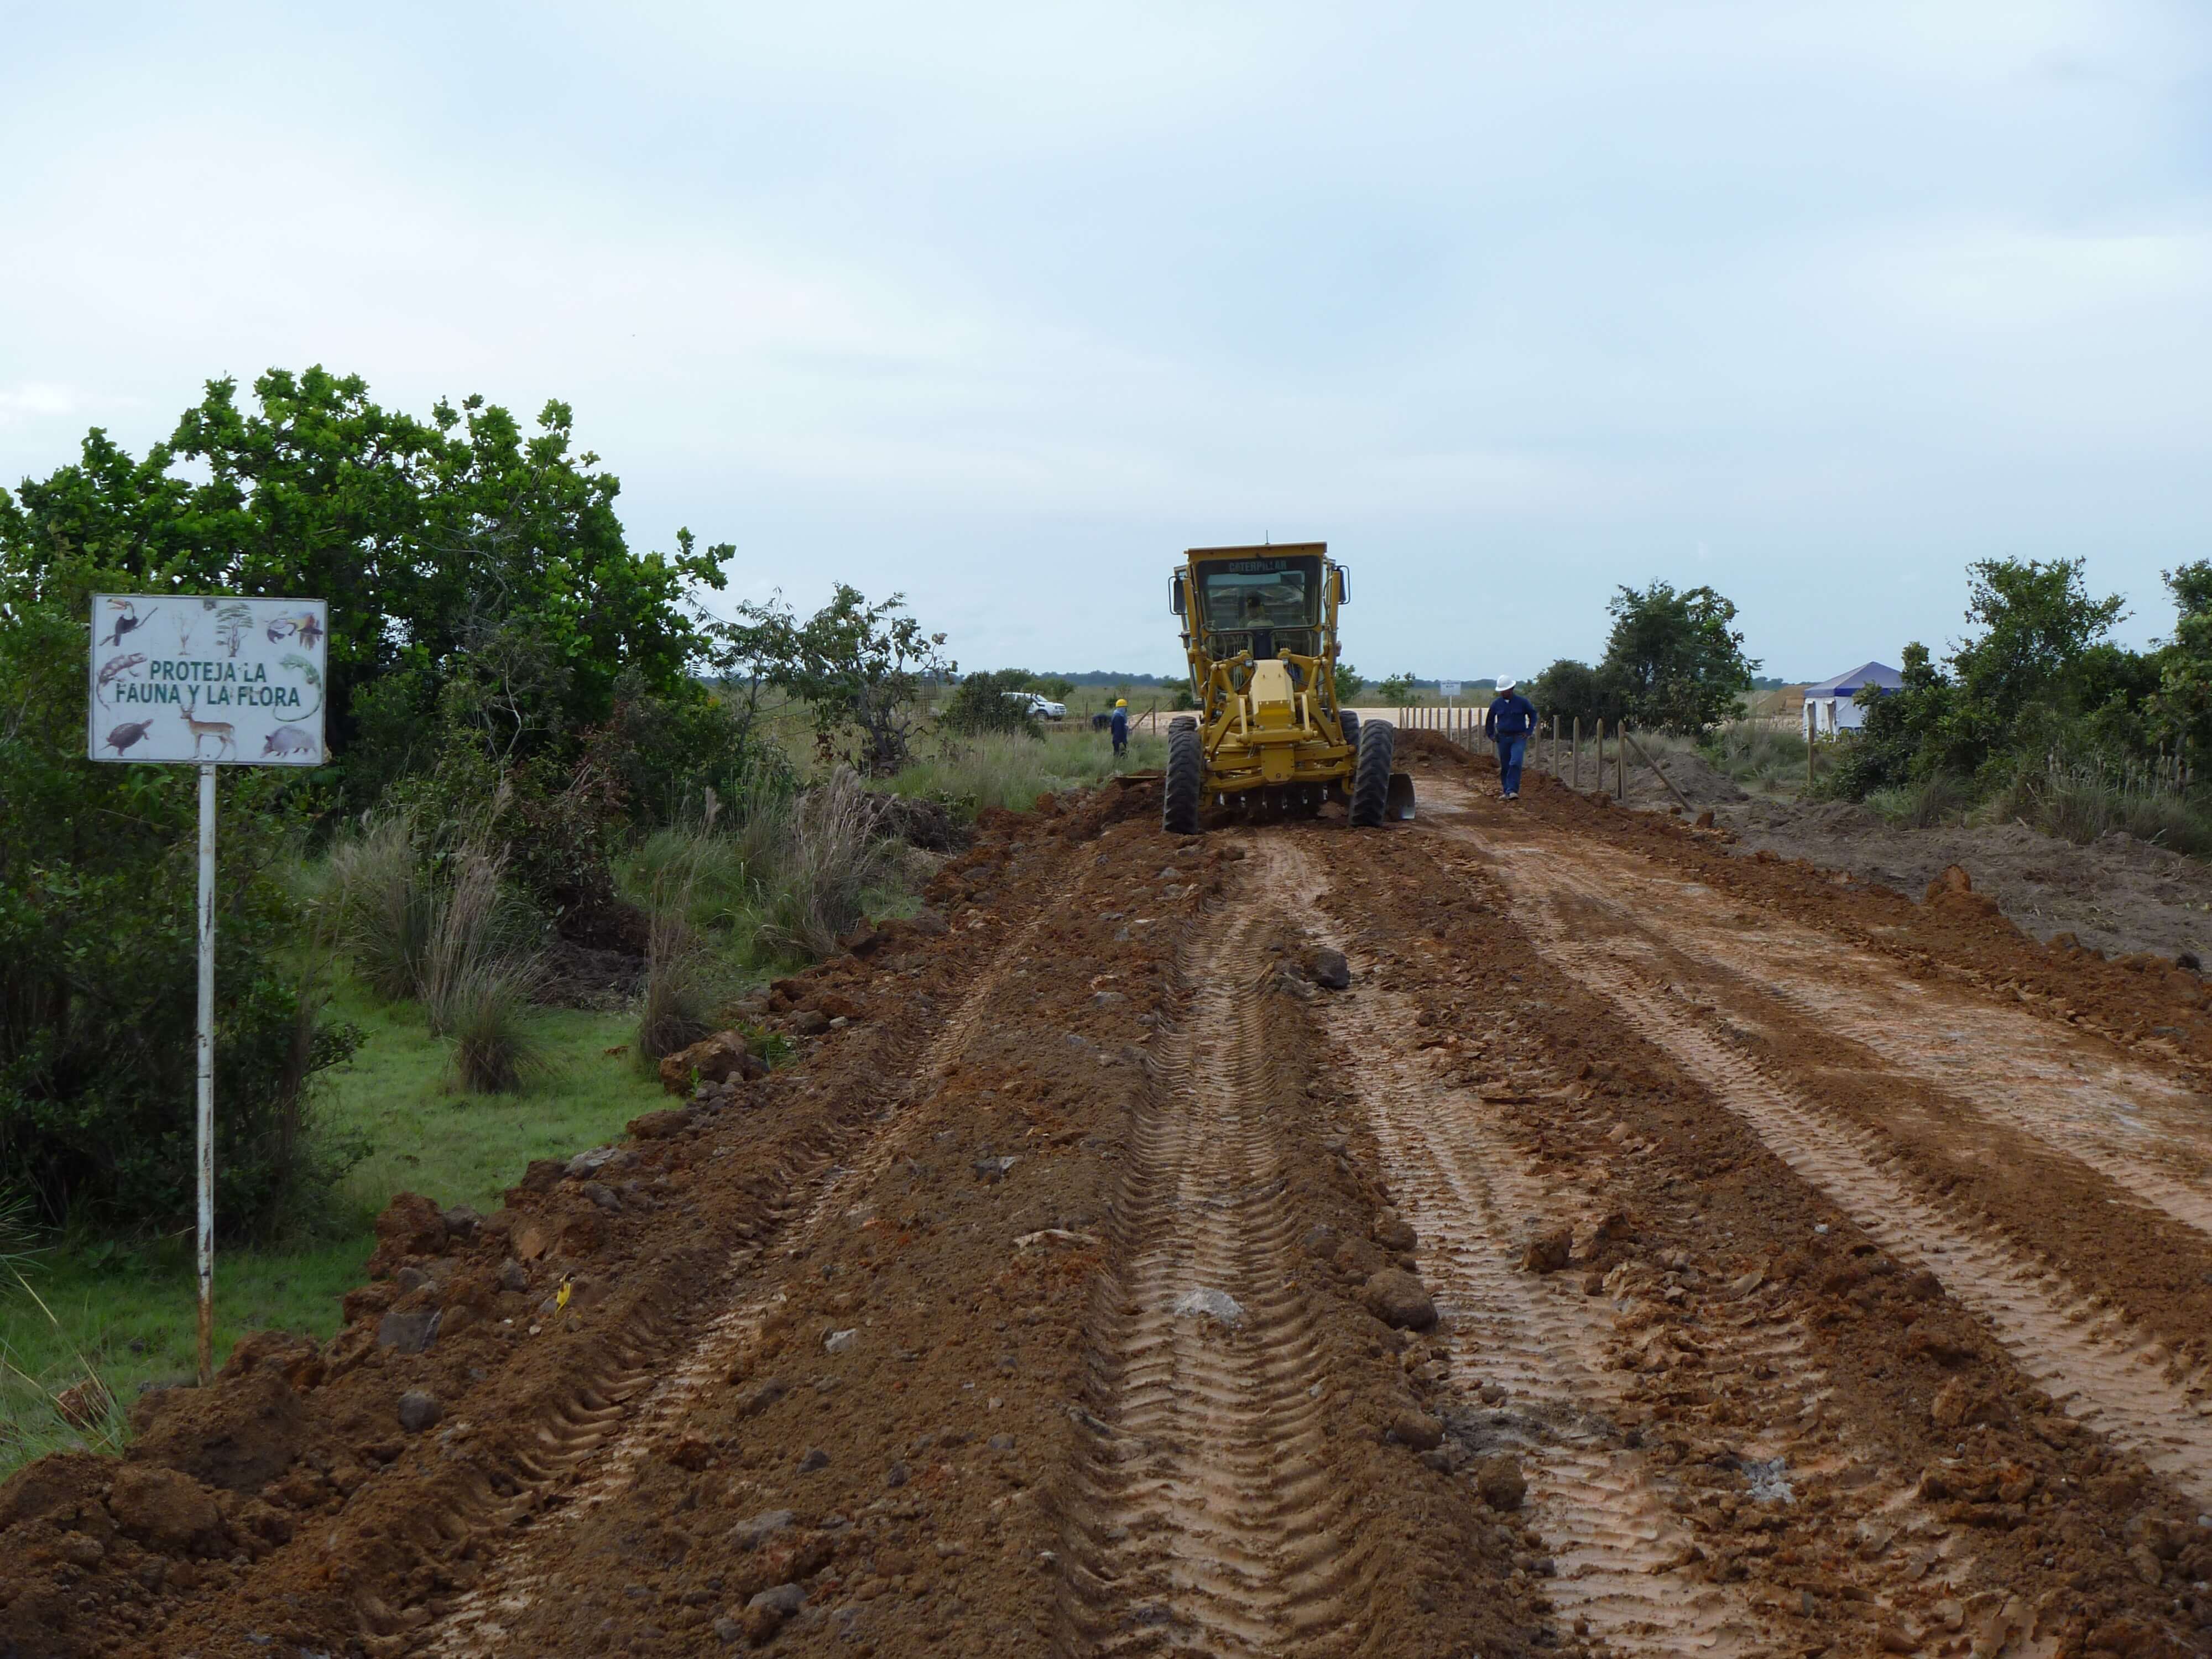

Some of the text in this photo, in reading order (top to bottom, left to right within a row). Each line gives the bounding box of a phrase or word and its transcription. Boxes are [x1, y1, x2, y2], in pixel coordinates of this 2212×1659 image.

[1229, 560, 1287, 572] CATERPILLAR
[150, 660, 267, 682] PROTEJA LA
[116, 683, 300, 706] FAUNA Y LA FLORA
